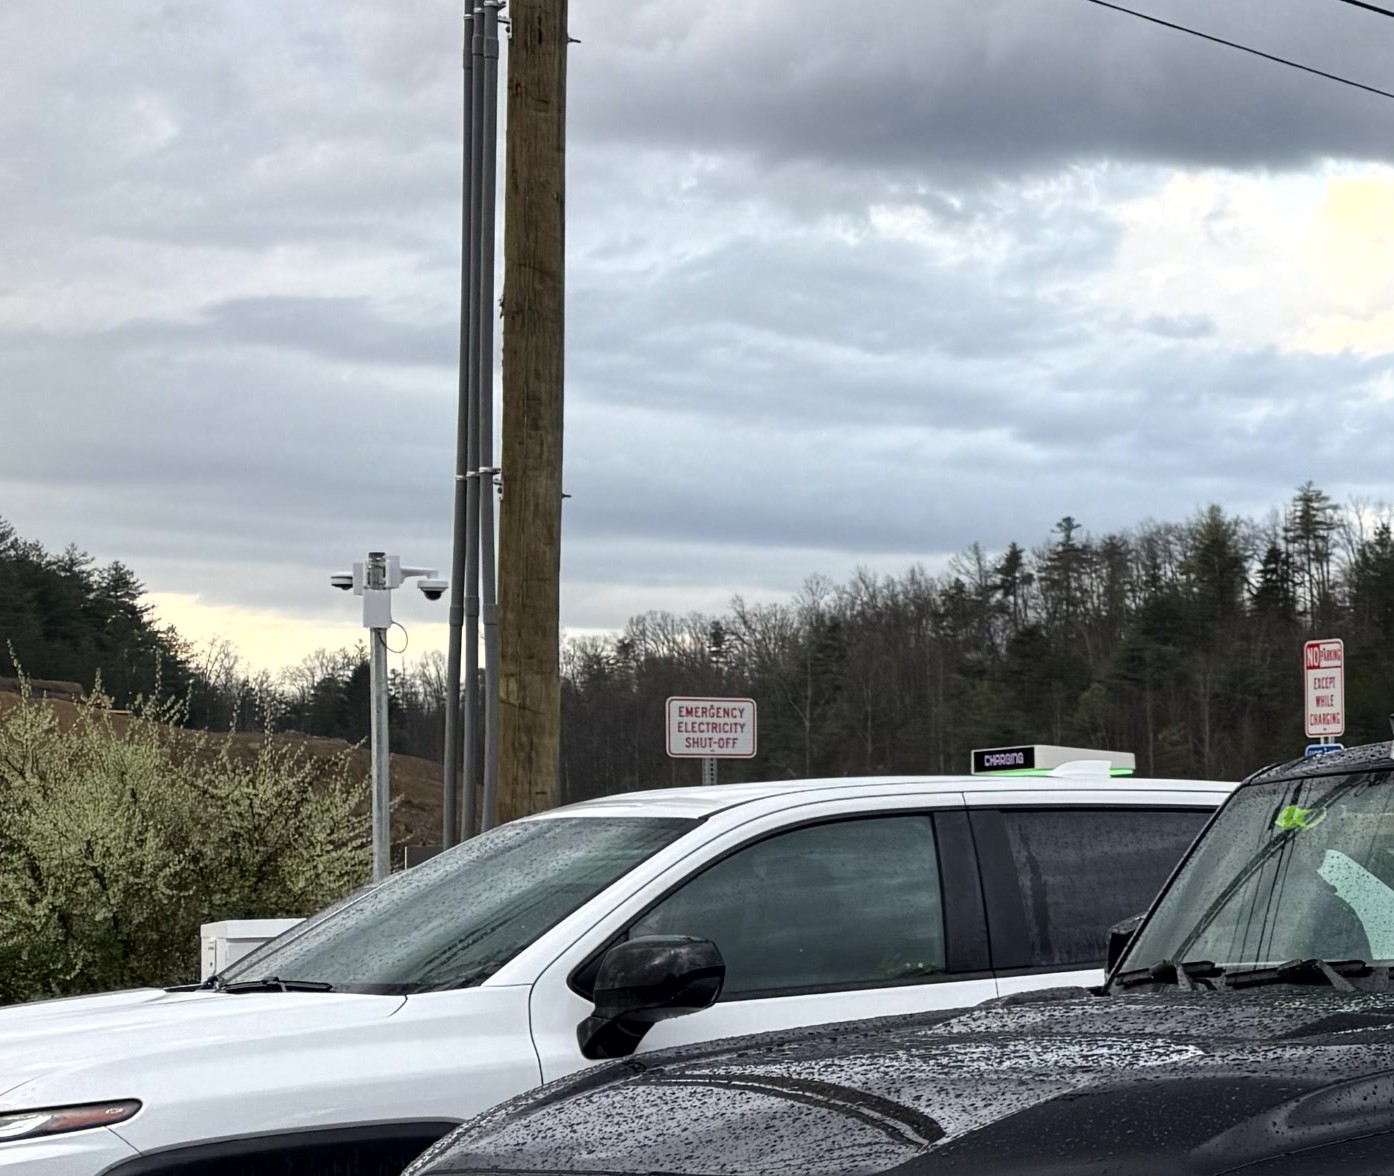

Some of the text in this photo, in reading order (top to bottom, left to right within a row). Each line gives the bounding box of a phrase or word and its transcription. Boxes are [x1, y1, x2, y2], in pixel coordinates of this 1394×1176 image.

[1307, 646, 1342, 667] NO PARKING
[1313, 676, 1336, 690] EXCEPT
[1315, 694, 1334, 708] WHILE
[678, 706, 745, 719] EMERGENCY
[1310, 712, 1341, 726] CHARGING
[677, 721, 746, 734] ELECTRICITY
[684, 737, 738, 749] SHUT-OFF
[984, 752, 1024, 767] CHARGING
